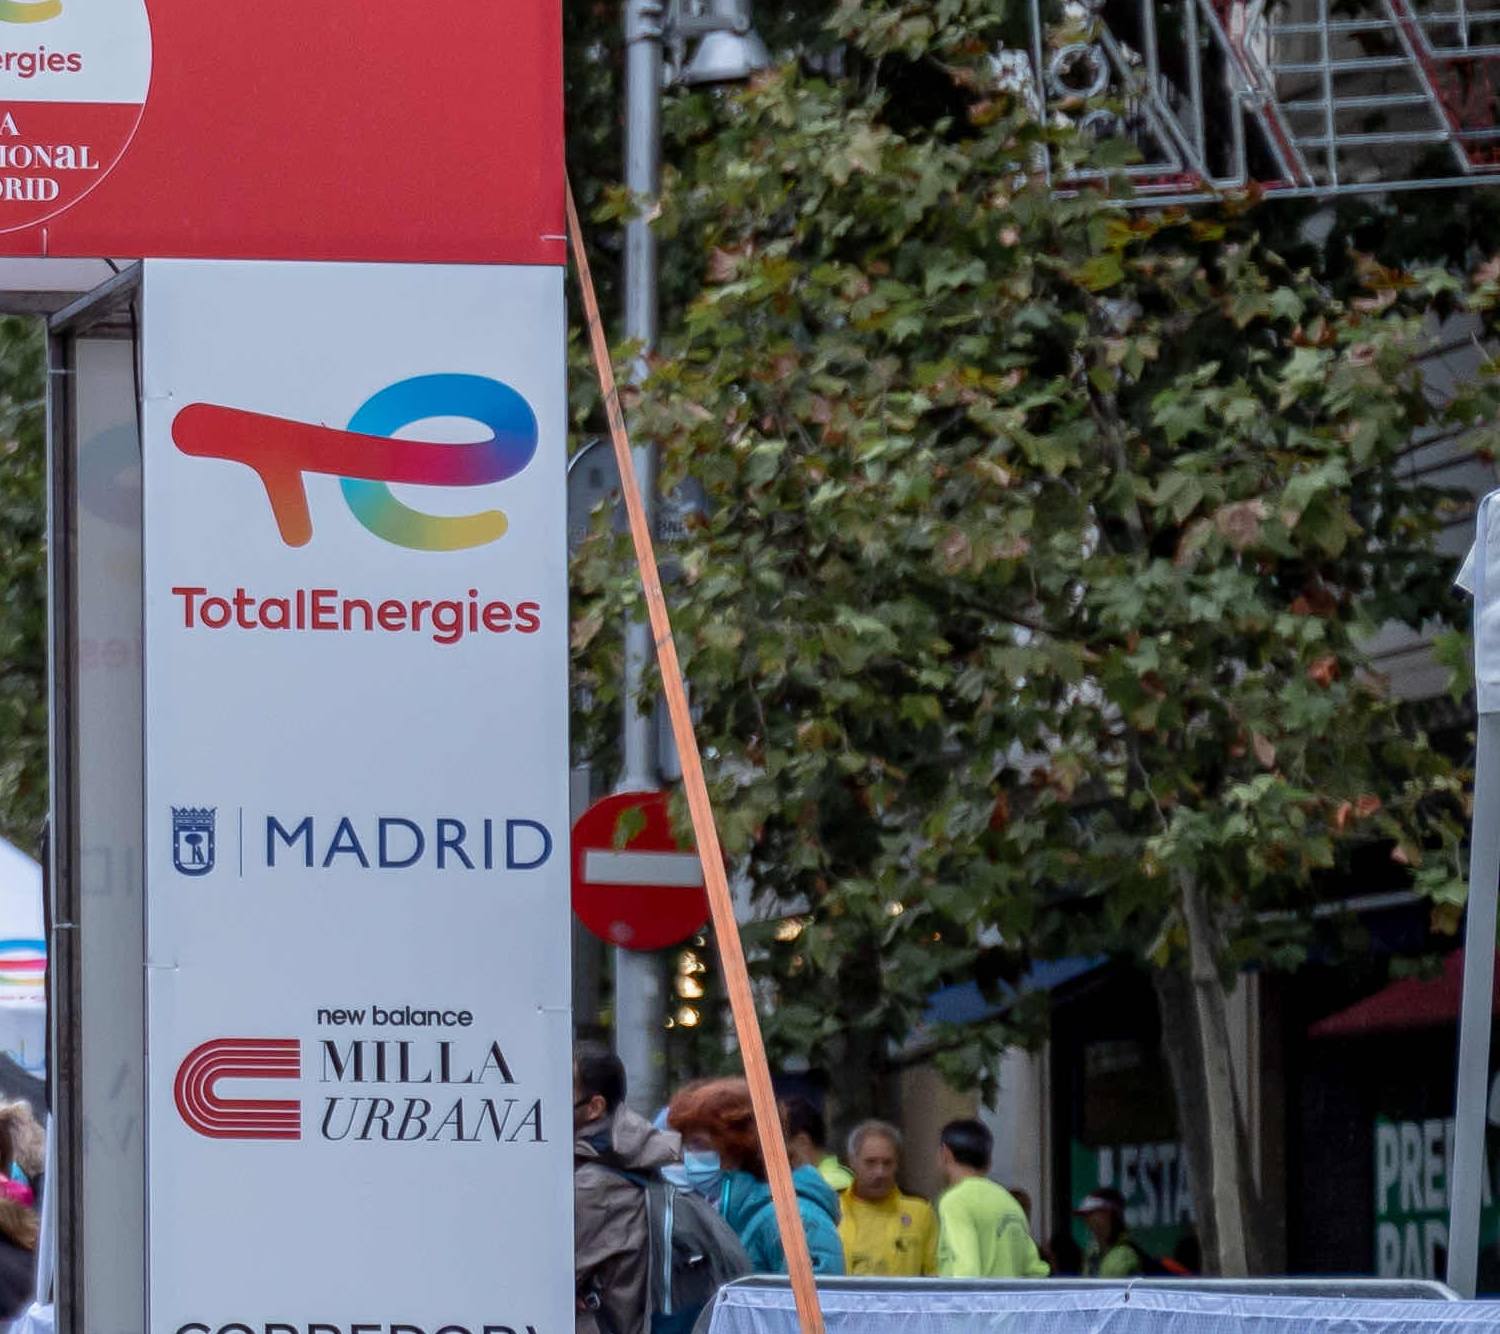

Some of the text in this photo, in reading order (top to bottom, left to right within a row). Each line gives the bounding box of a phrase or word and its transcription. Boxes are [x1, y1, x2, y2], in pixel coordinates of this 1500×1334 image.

[171, 586, 541, 645] TotalEnergies
[266, 815, 553, 871] MADRID
[317, 1004, 474, 1027] new balance
[318, 1039, 521, 1085] MILLA
[321, 1097, 549, 1143] URBANA
